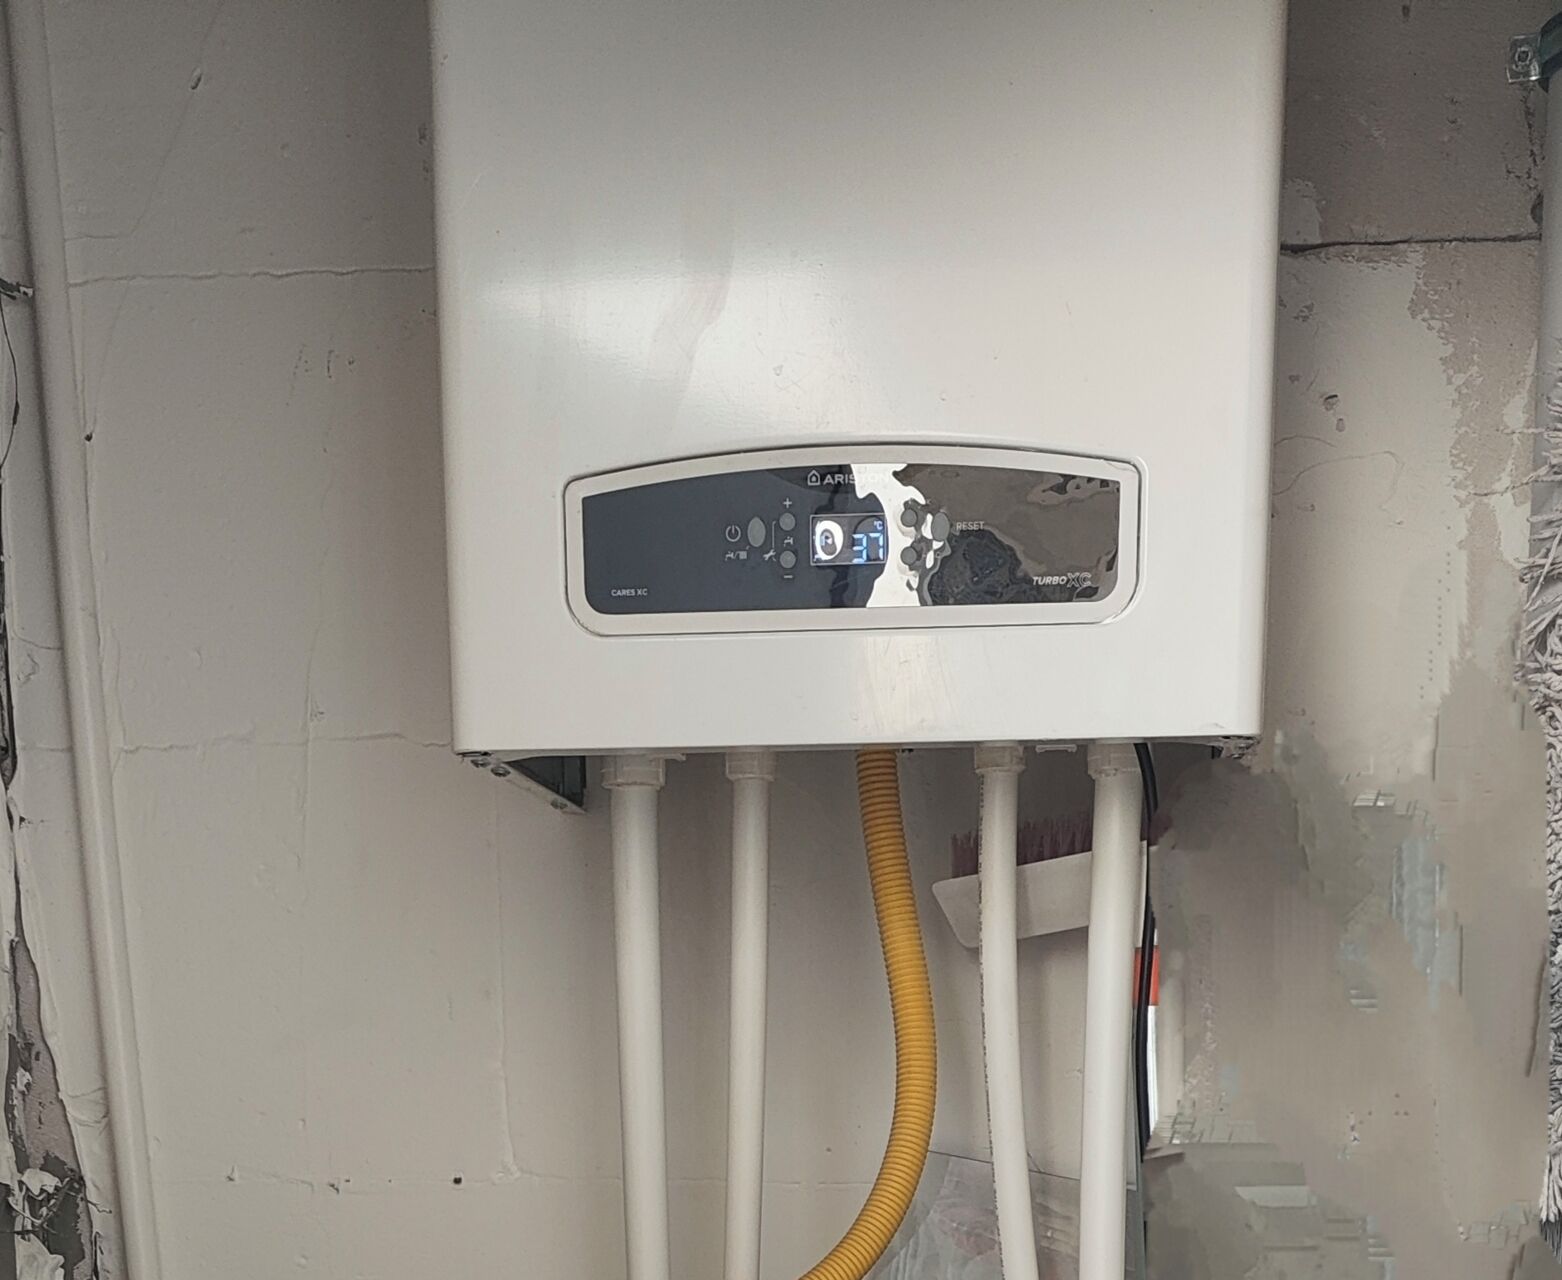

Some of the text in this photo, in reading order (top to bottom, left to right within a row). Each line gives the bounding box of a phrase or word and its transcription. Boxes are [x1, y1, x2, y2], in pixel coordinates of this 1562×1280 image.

[956, 521, 985, 531] RESET
[852, 532, 885, 563] 37
[611, 588, 648, 597] CARES XC
